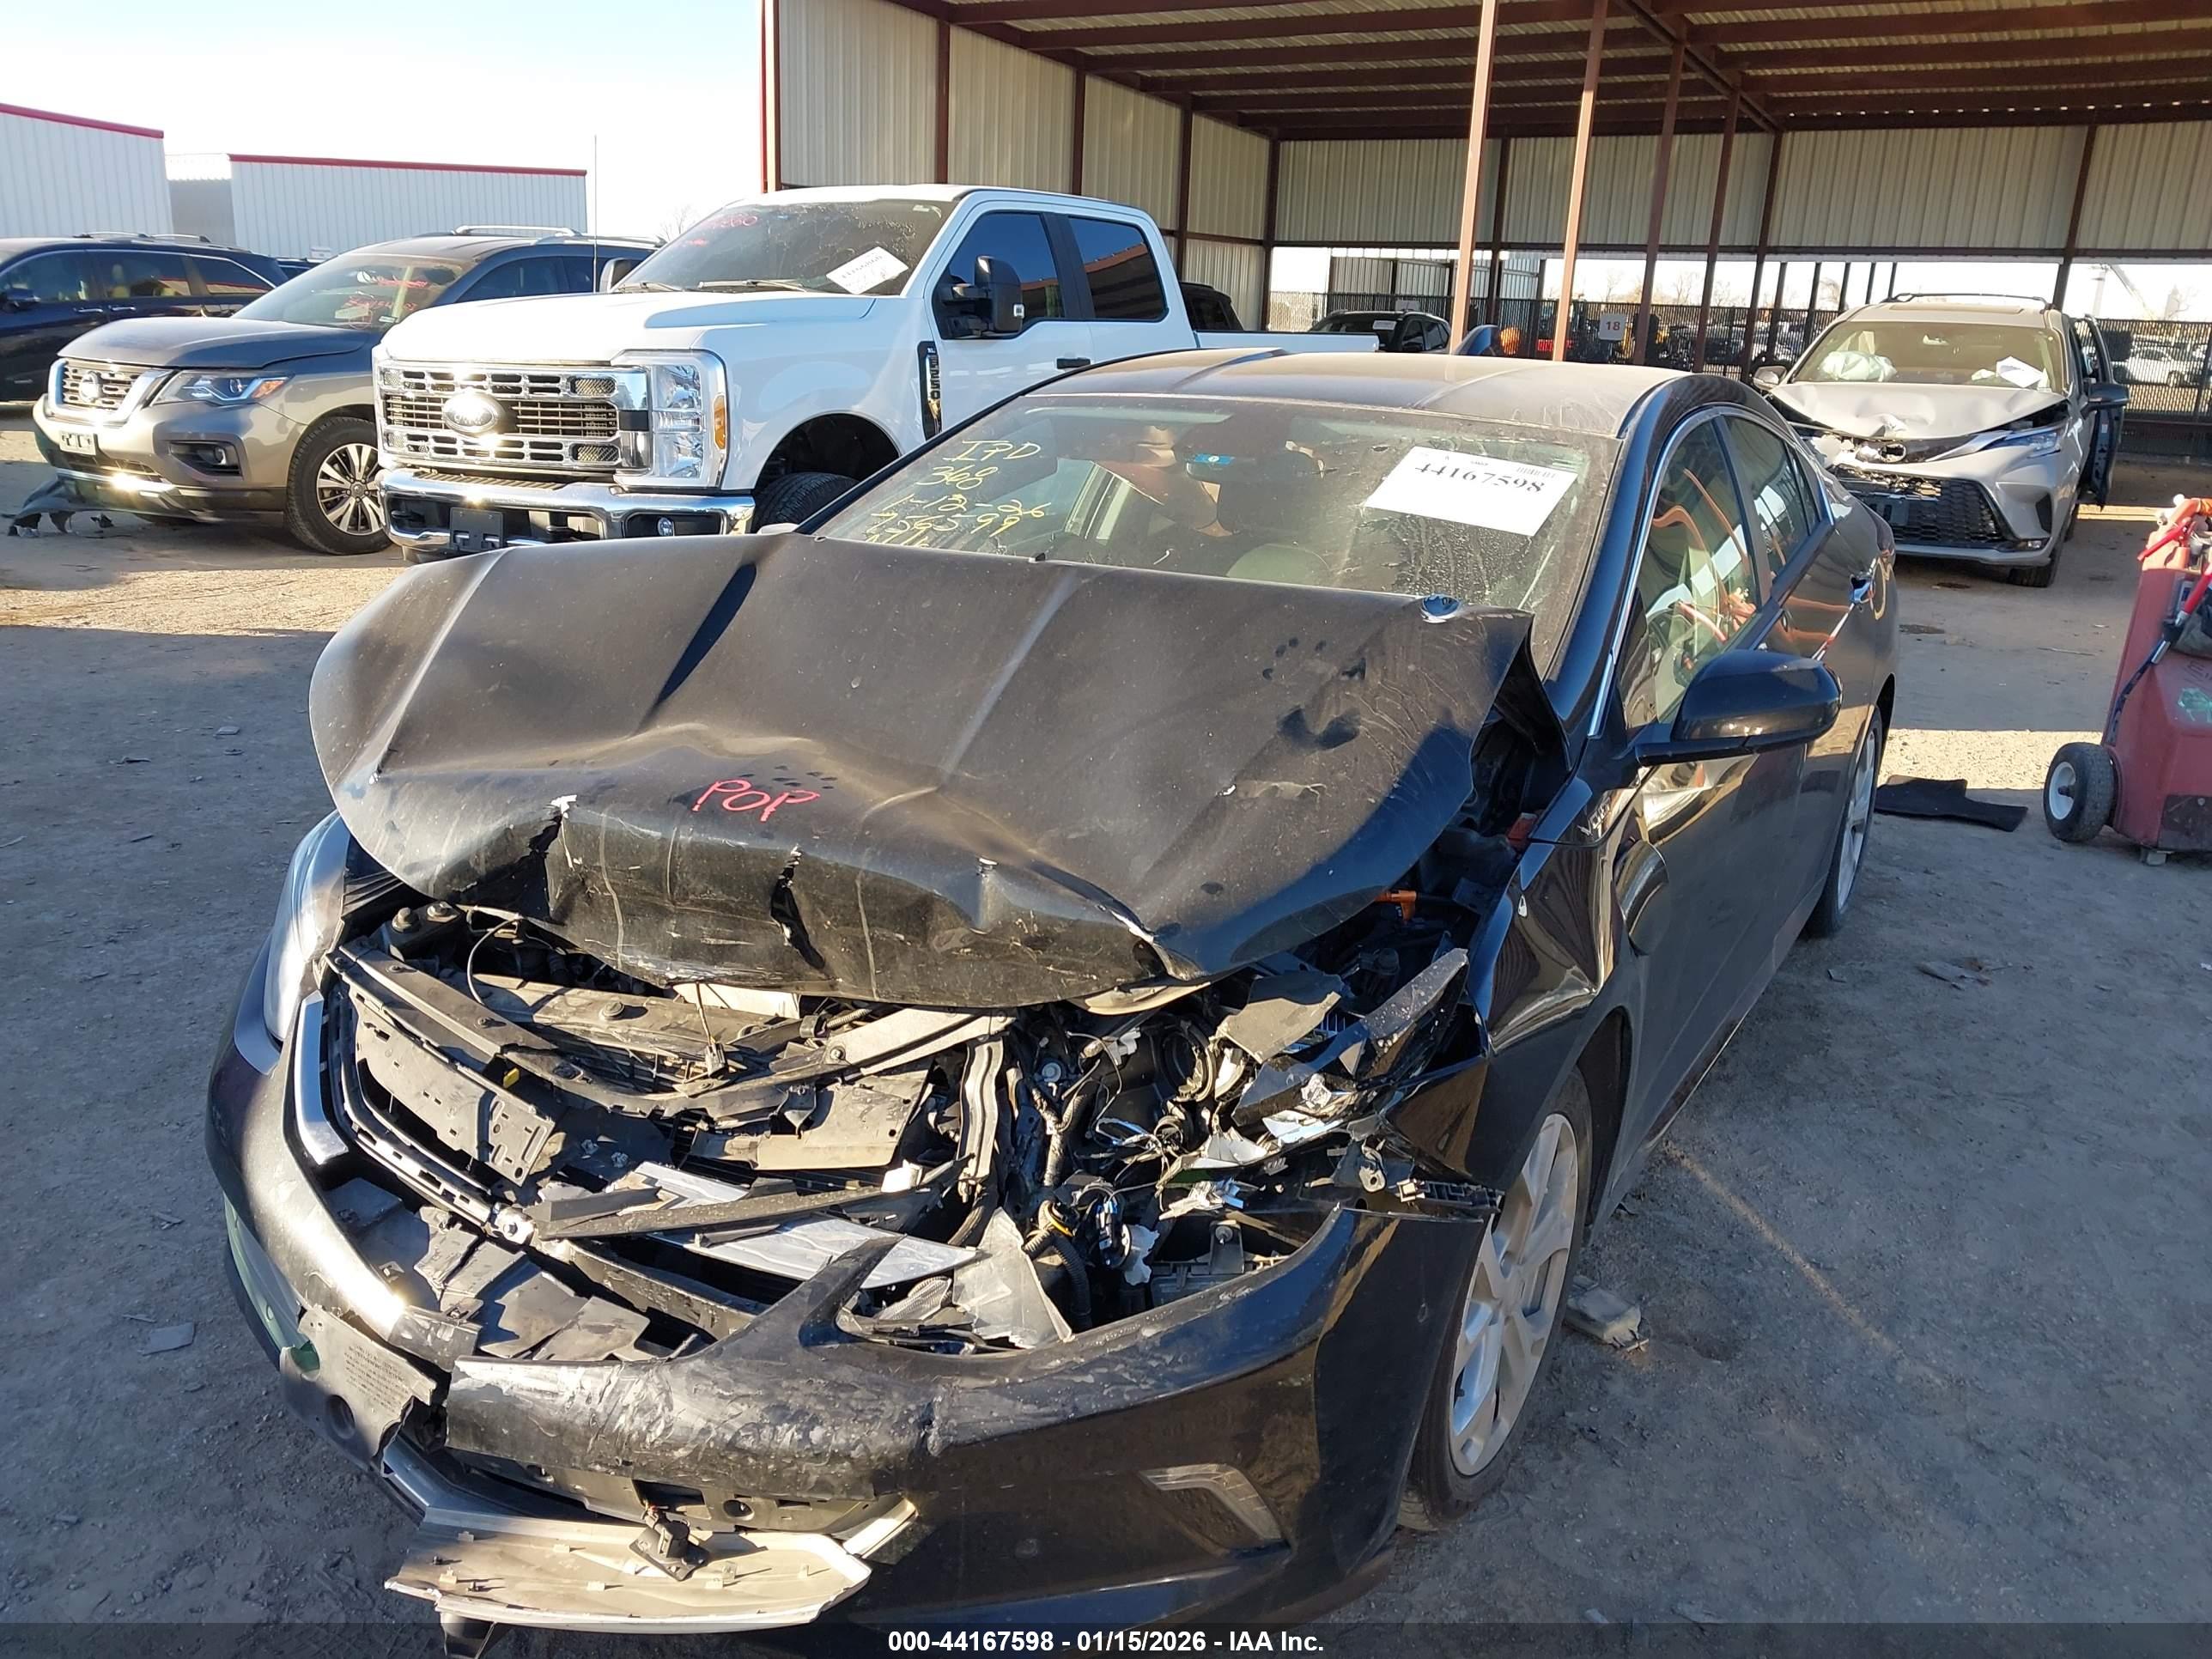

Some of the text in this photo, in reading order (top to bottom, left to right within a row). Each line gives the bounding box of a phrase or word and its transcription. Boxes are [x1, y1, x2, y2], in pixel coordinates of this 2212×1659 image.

[1606, 321, 1620, 331] 18
[1414, 463, 1545, 493] 44167598
[691, 778, 821, 823] POP
